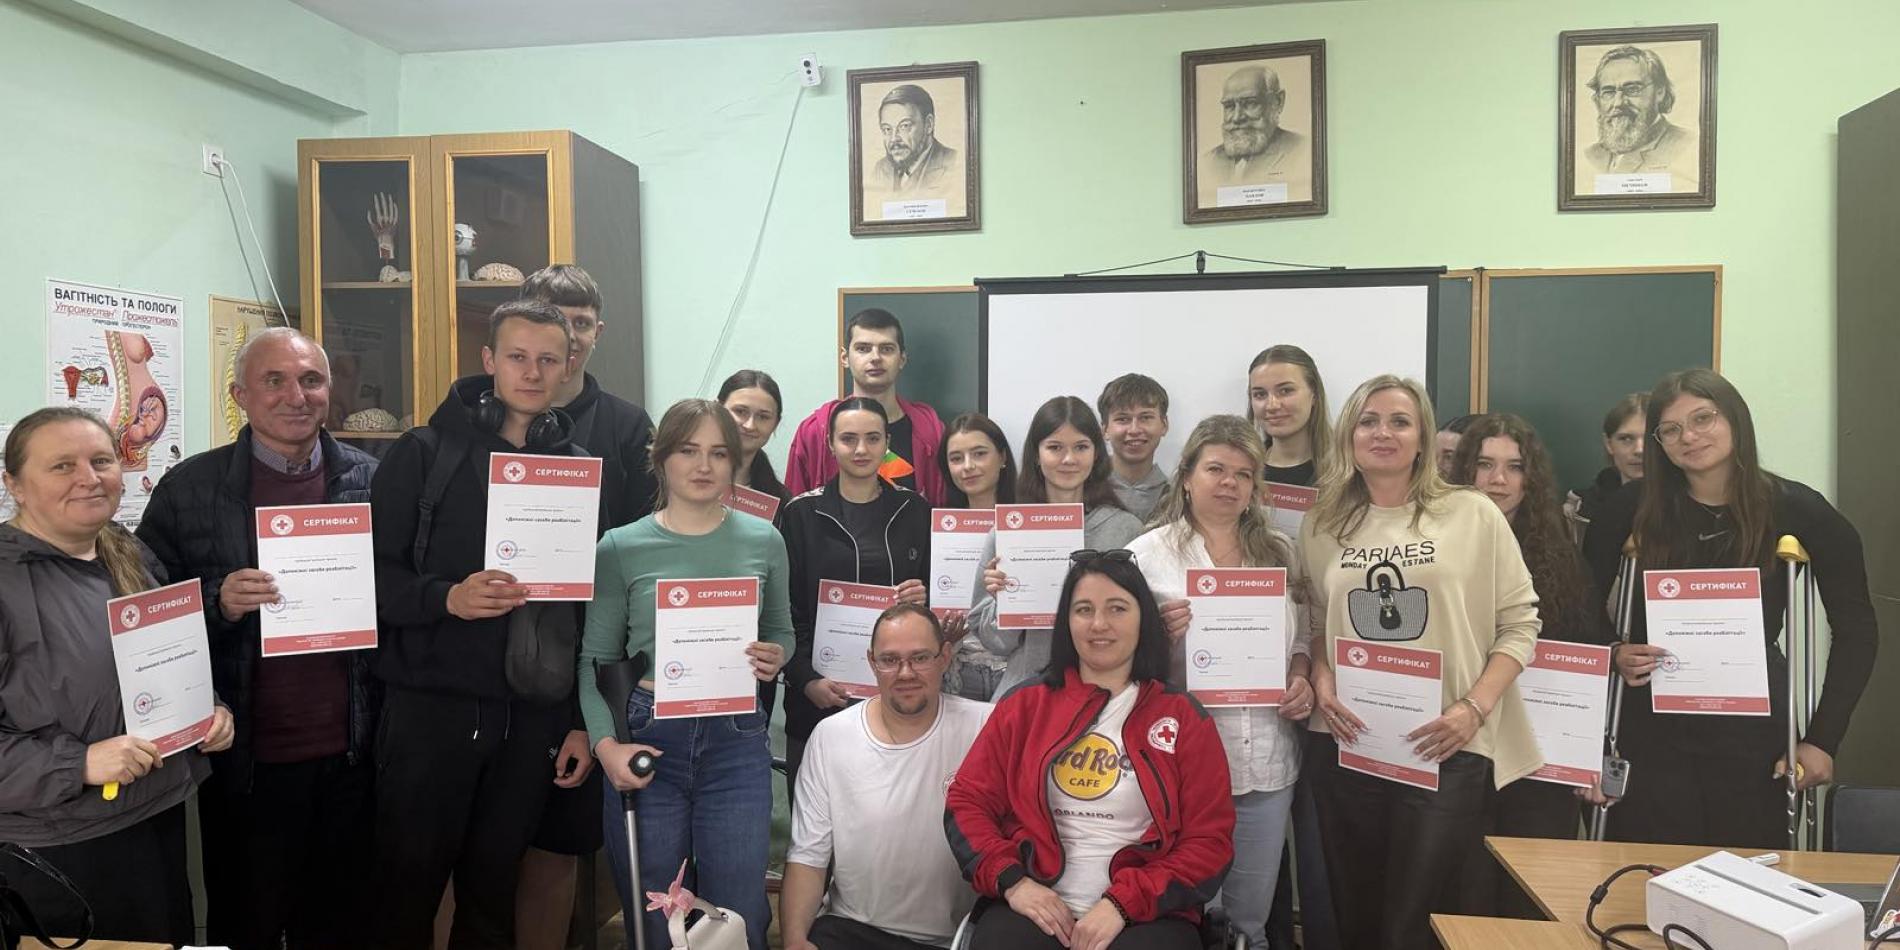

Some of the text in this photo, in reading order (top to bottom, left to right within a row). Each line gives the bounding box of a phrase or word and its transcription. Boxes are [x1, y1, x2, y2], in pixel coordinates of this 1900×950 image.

[54, 287, 177, 315] ВАГІТНІСТЬ ТА ПОЛОГИ
[535, 467, 590, 479] СЕРТИФІКАТ
[303, 516, 359, 528] СЕРТИФІКАТ
[1030, 515, 1074, 523] СЕРТИФІКАТ
[1225, 579, 1275, 588] СЕРТИФІКАТ
[1690, 581, 1747, 592] СЕРТИФІКАТ
[697, 589, 748, 600] СЕРТИФІКАТ
[850, 592, 889, 604] СЕРТИФІКАТ
[147, 595, 192, 615] СЕРТИФІКАТ
[1376, 654, 1431, 670] СЕРТИФІКАТ
[1544, 652, 1599, 667] СЕРТИФІКАТ
[1069, 778, 1101, 788] CAFE
